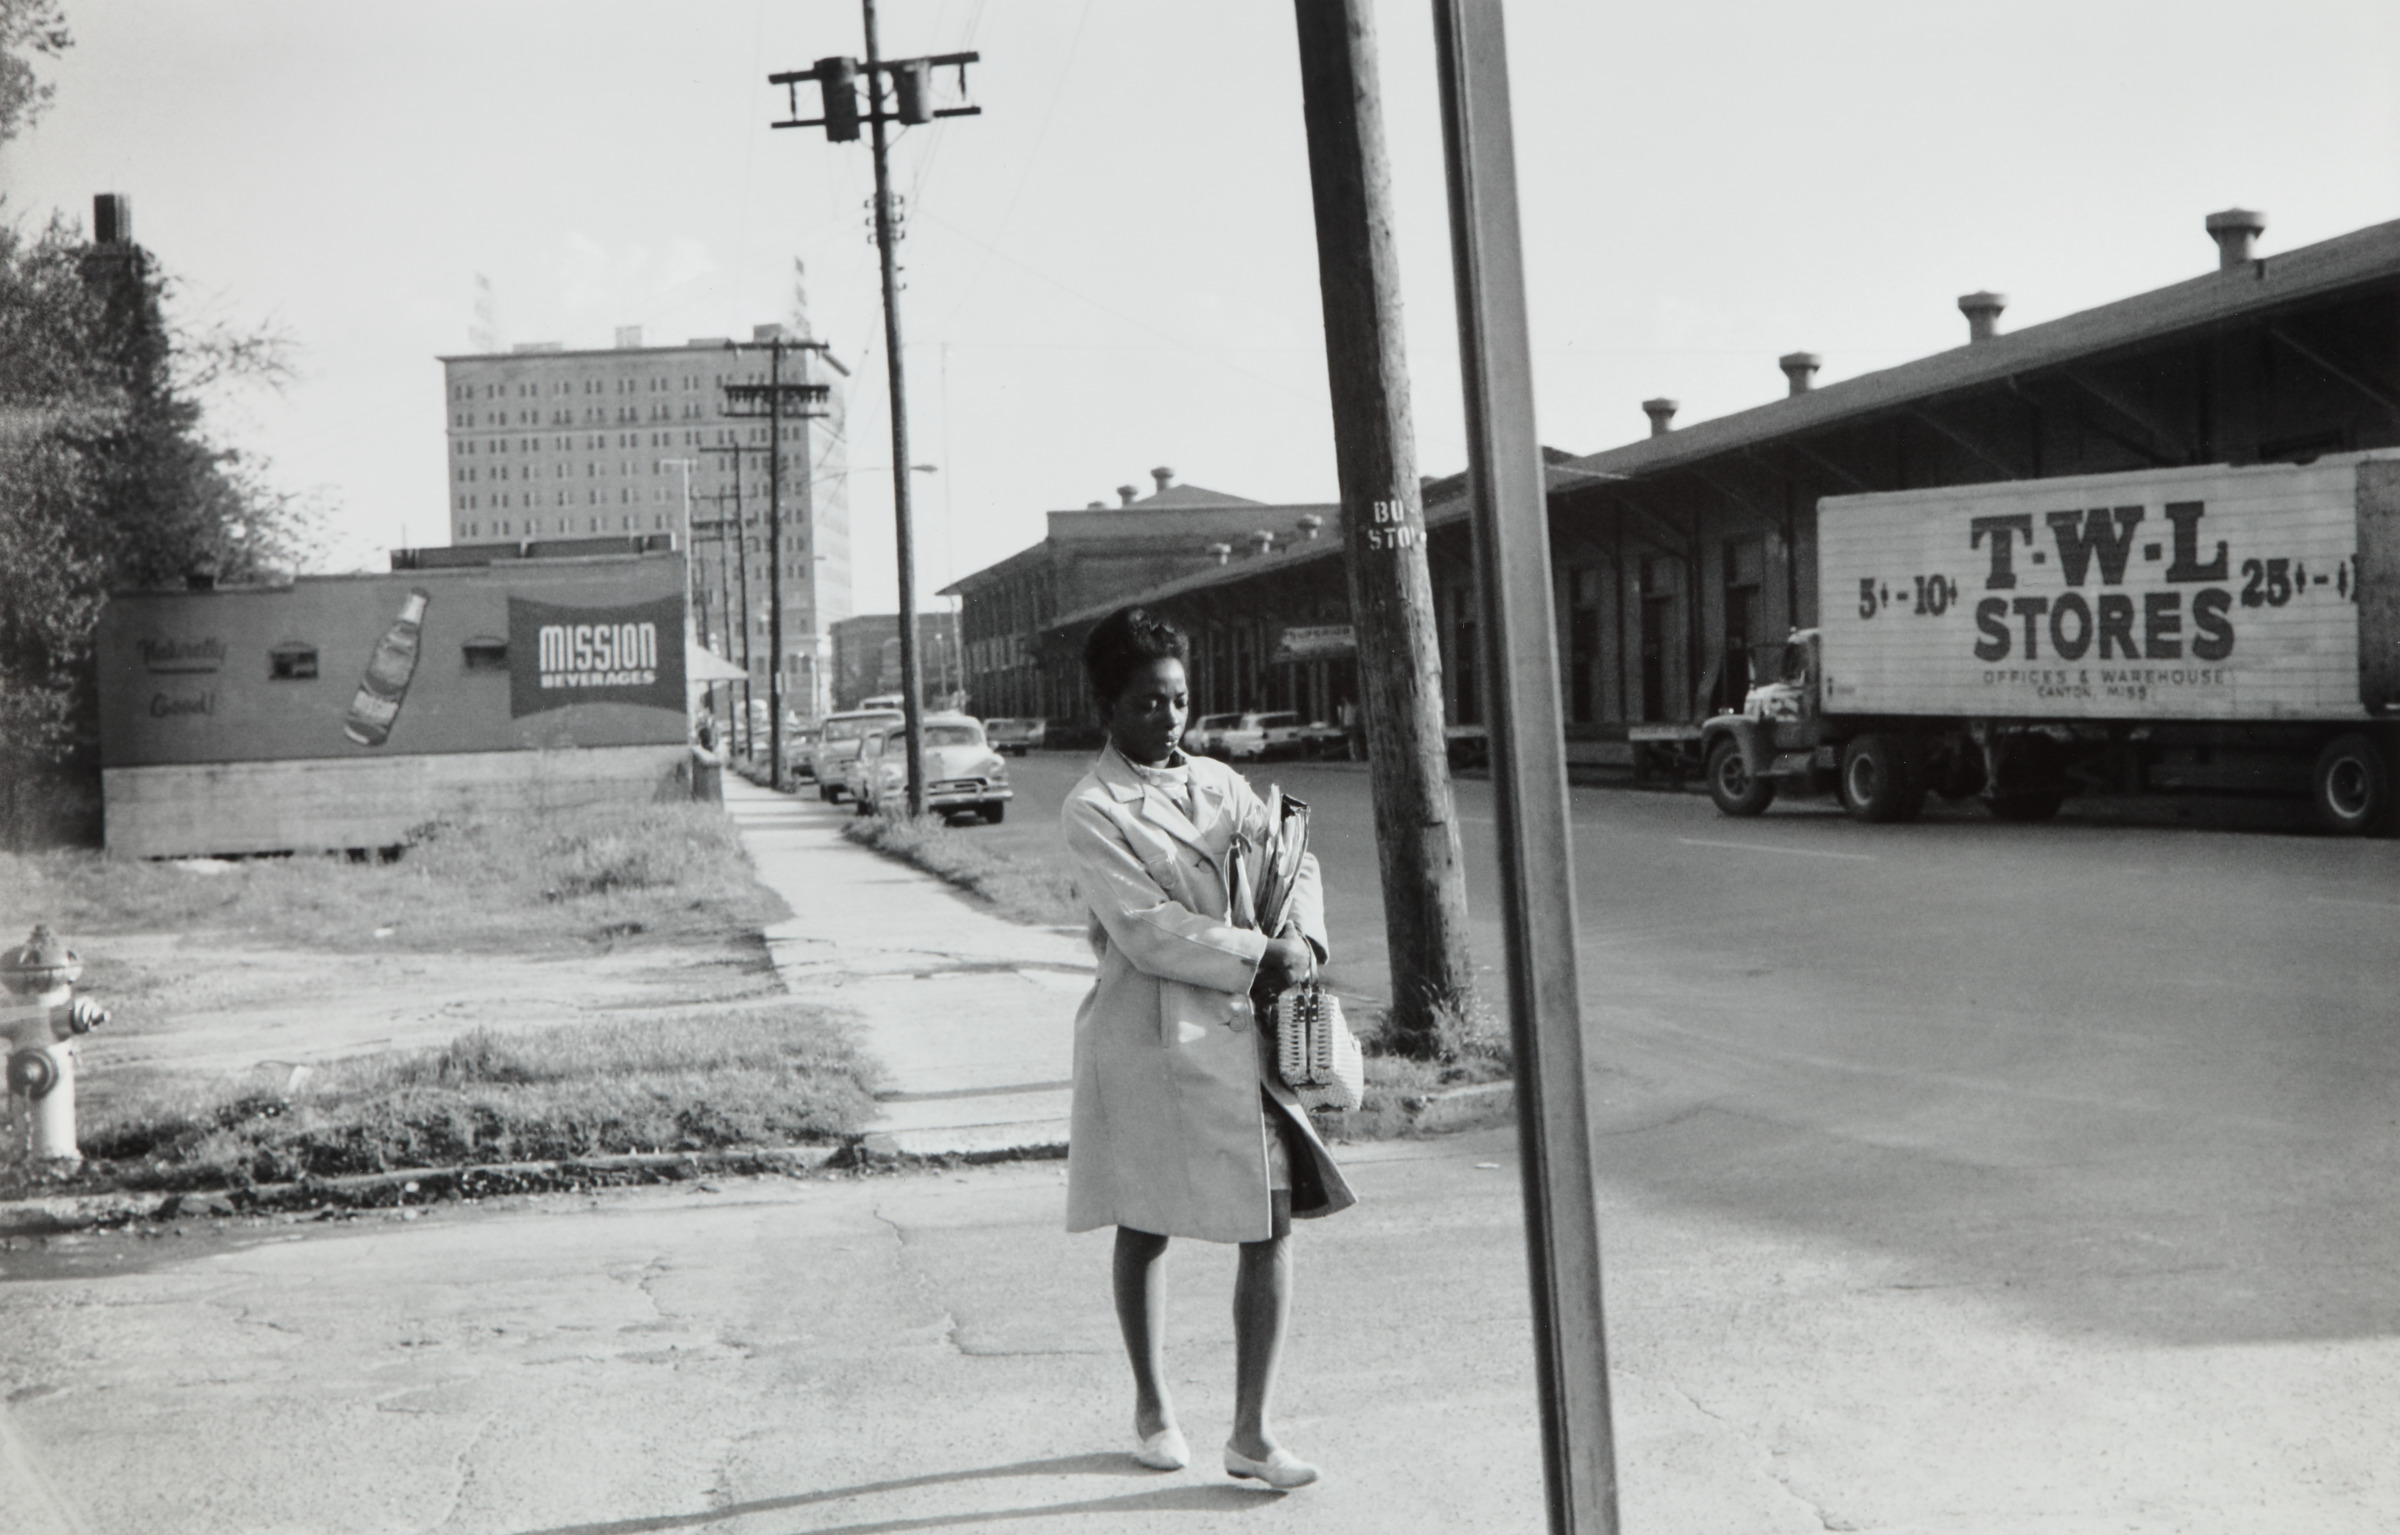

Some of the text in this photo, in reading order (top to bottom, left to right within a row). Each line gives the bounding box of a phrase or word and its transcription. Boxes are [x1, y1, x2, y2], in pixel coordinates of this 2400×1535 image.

[1974, 587, 2235, 662] STORES
[539, 621, 658, 672] MISSION
[540, 670, 656, 689] BEVERAGES
[1983, 668, 2225, 686] OFFICES & WAREHOUSE
